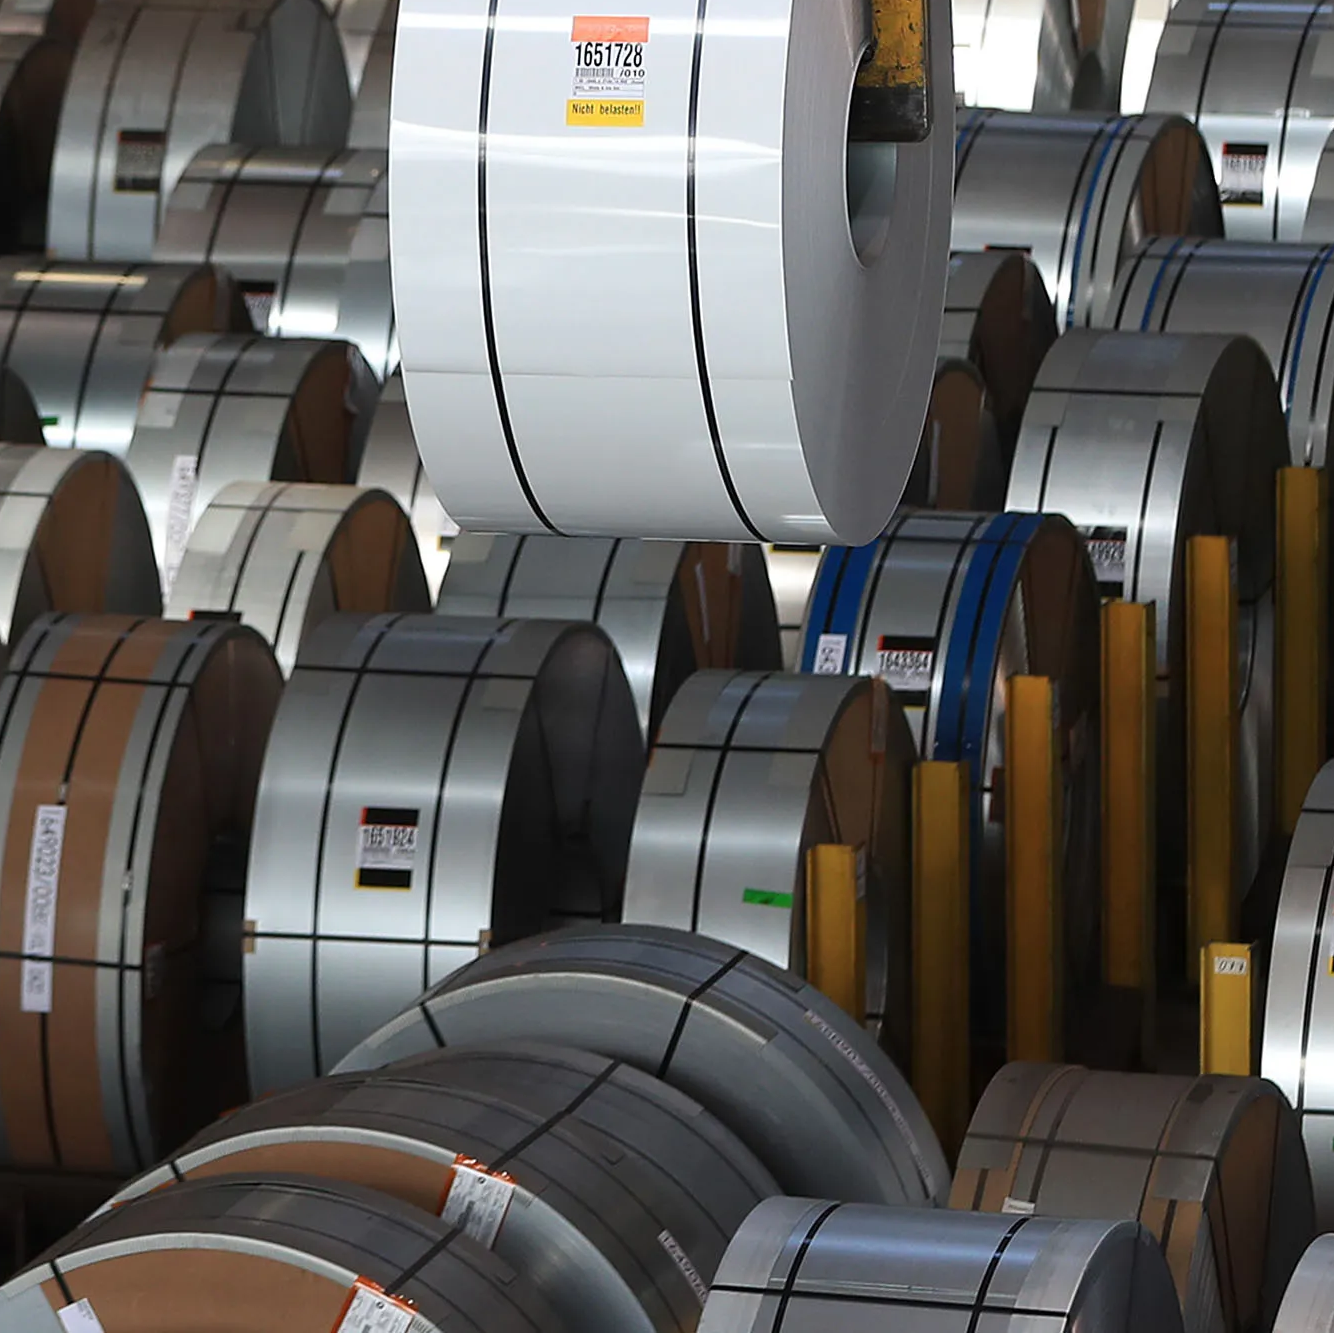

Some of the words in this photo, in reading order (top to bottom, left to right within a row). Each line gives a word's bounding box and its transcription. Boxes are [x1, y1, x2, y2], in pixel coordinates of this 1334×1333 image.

[575, 41, 643, 67] 1651728
[620, 68, 645, 78] /010
[572, 103, 594, 115] Nicht
